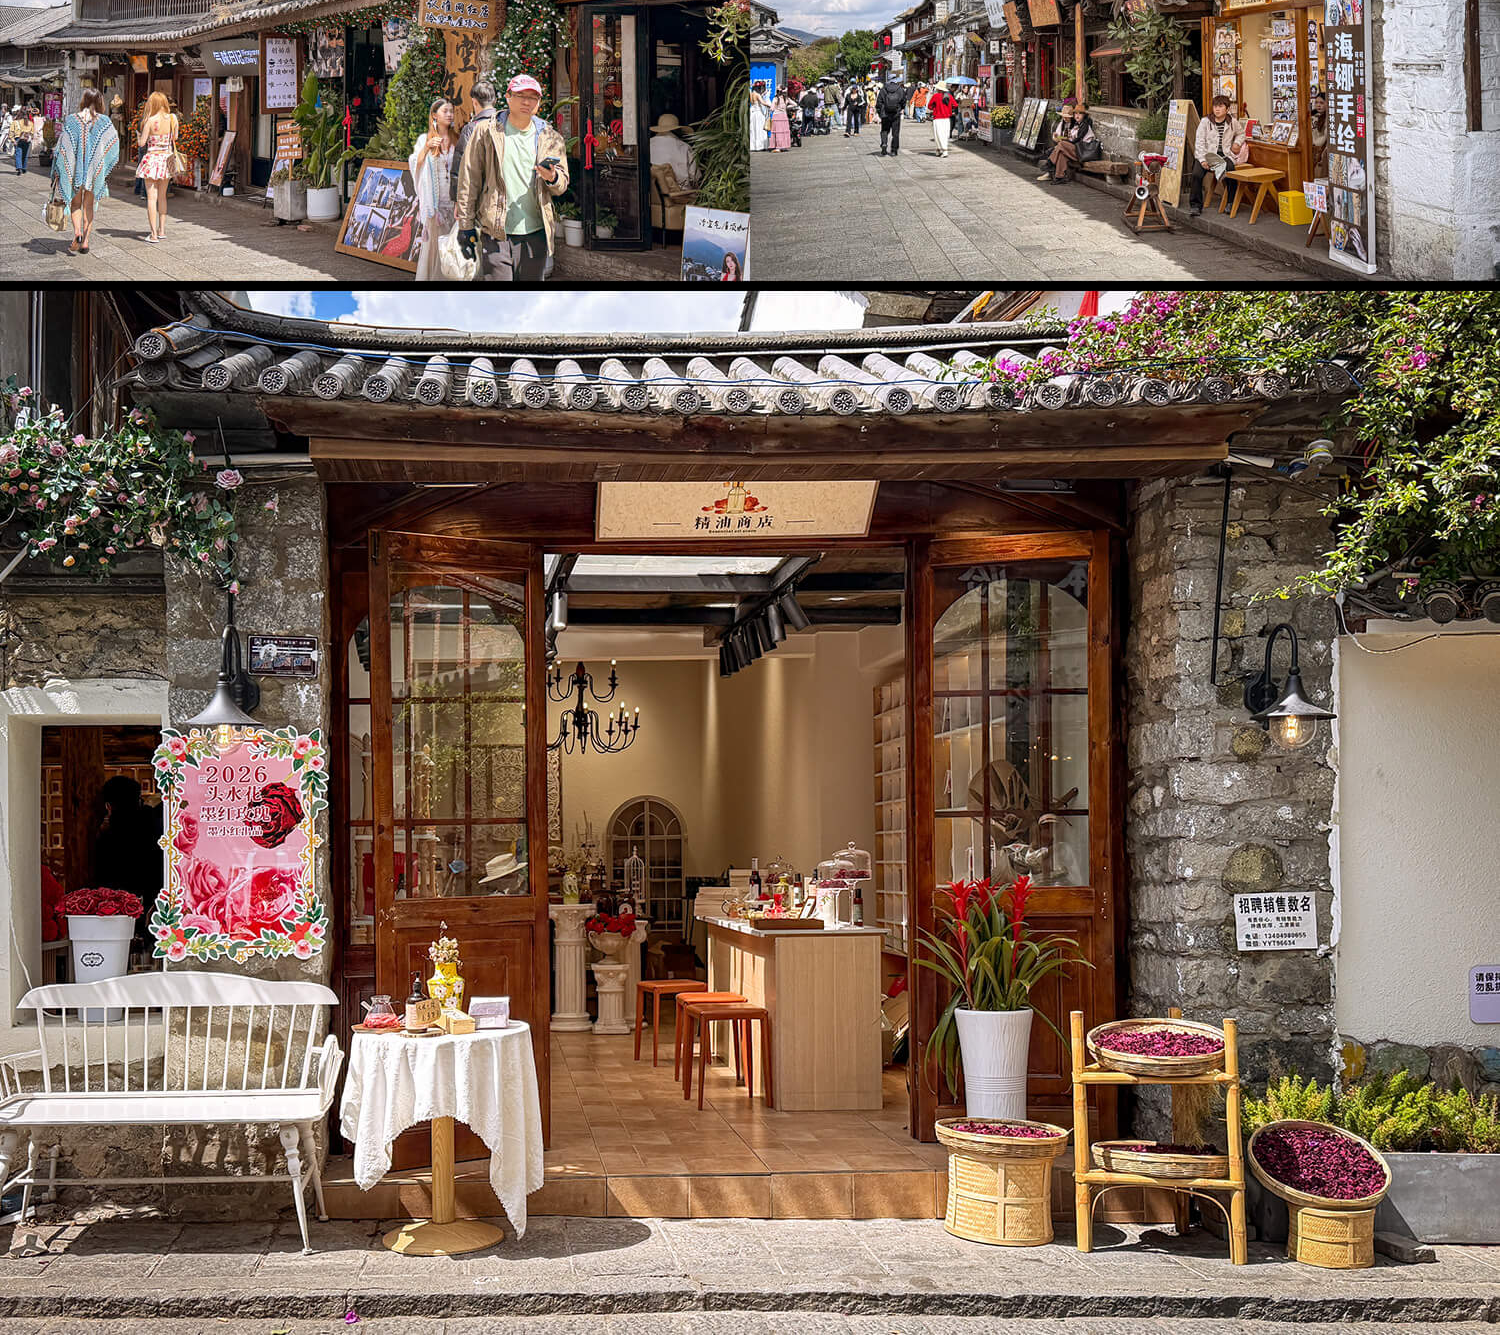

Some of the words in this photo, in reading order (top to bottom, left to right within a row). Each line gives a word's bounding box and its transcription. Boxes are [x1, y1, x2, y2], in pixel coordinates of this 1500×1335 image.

[441, 30, 478, 106] 空气
[1335, 32, 1356, 153] 海娜手绘
[694, 515, 775, 530] 精油商店
[205, 765, 268, 783] 2026
[206, 785, 263, 802] 头水花
[200, 805, 271, 822] 墨红玫瑰
[207, 826, 263, 836] 墨小红出品
[1238, 895, 1311, 914] 招聘销售数名
